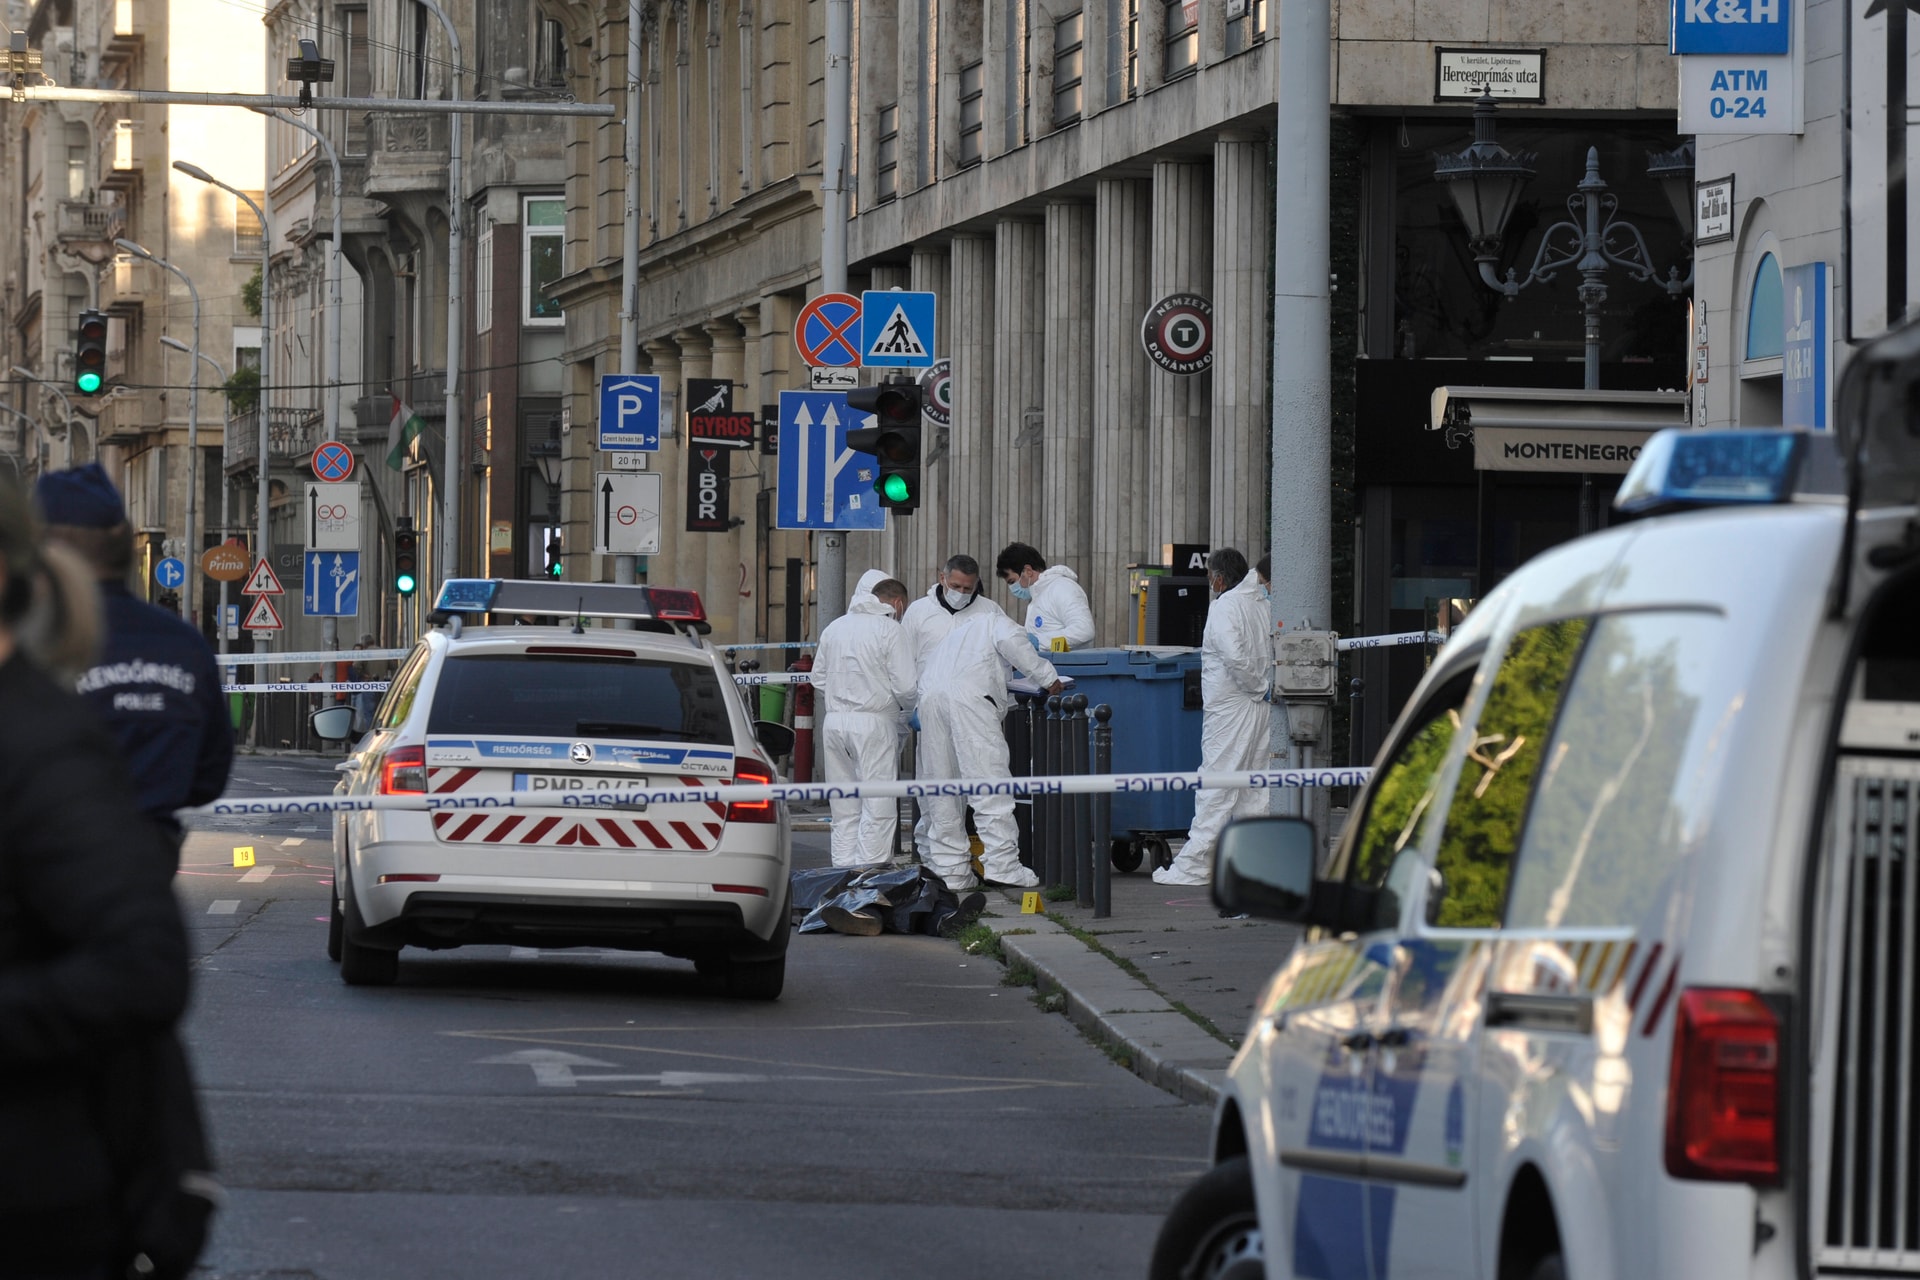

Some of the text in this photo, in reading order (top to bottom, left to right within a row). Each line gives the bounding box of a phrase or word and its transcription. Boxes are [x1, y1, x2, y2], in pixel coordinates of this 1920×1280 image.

[1685, 0, 1779, 23] K&H
[1490, 57, 1521, 65] Lipótváros
[1443, 66, 1537, 86] Hercegprímás utca
[1710, 70, 1768, 91] ATM
[1463, 86, 1468, 94] 2
[1710, 97, 1766, 118] 0-24
[1156, 297, 1212, 316] NEMZETI
[1177, 327, 1193, 342] T
[1786, 347, 1811, 380] K&H
[617, 394, 642, 429] P
[692, 416, 752, 437] GYROS
[618, 457, 629, 465] 20
[698, 473, 718, 519] BOR
[208, 560, 244, 571] Prima
[1349, 639, 1380, 649] POLICE
[267, 683, 308, 691] POLICE
[113, 692, 165, 711] POLICE
[681, 763, 728, 772] OCTAVIA
[1115, 776, 1203, 792] POLICE
[772, 788, 860, 800] POLICE
